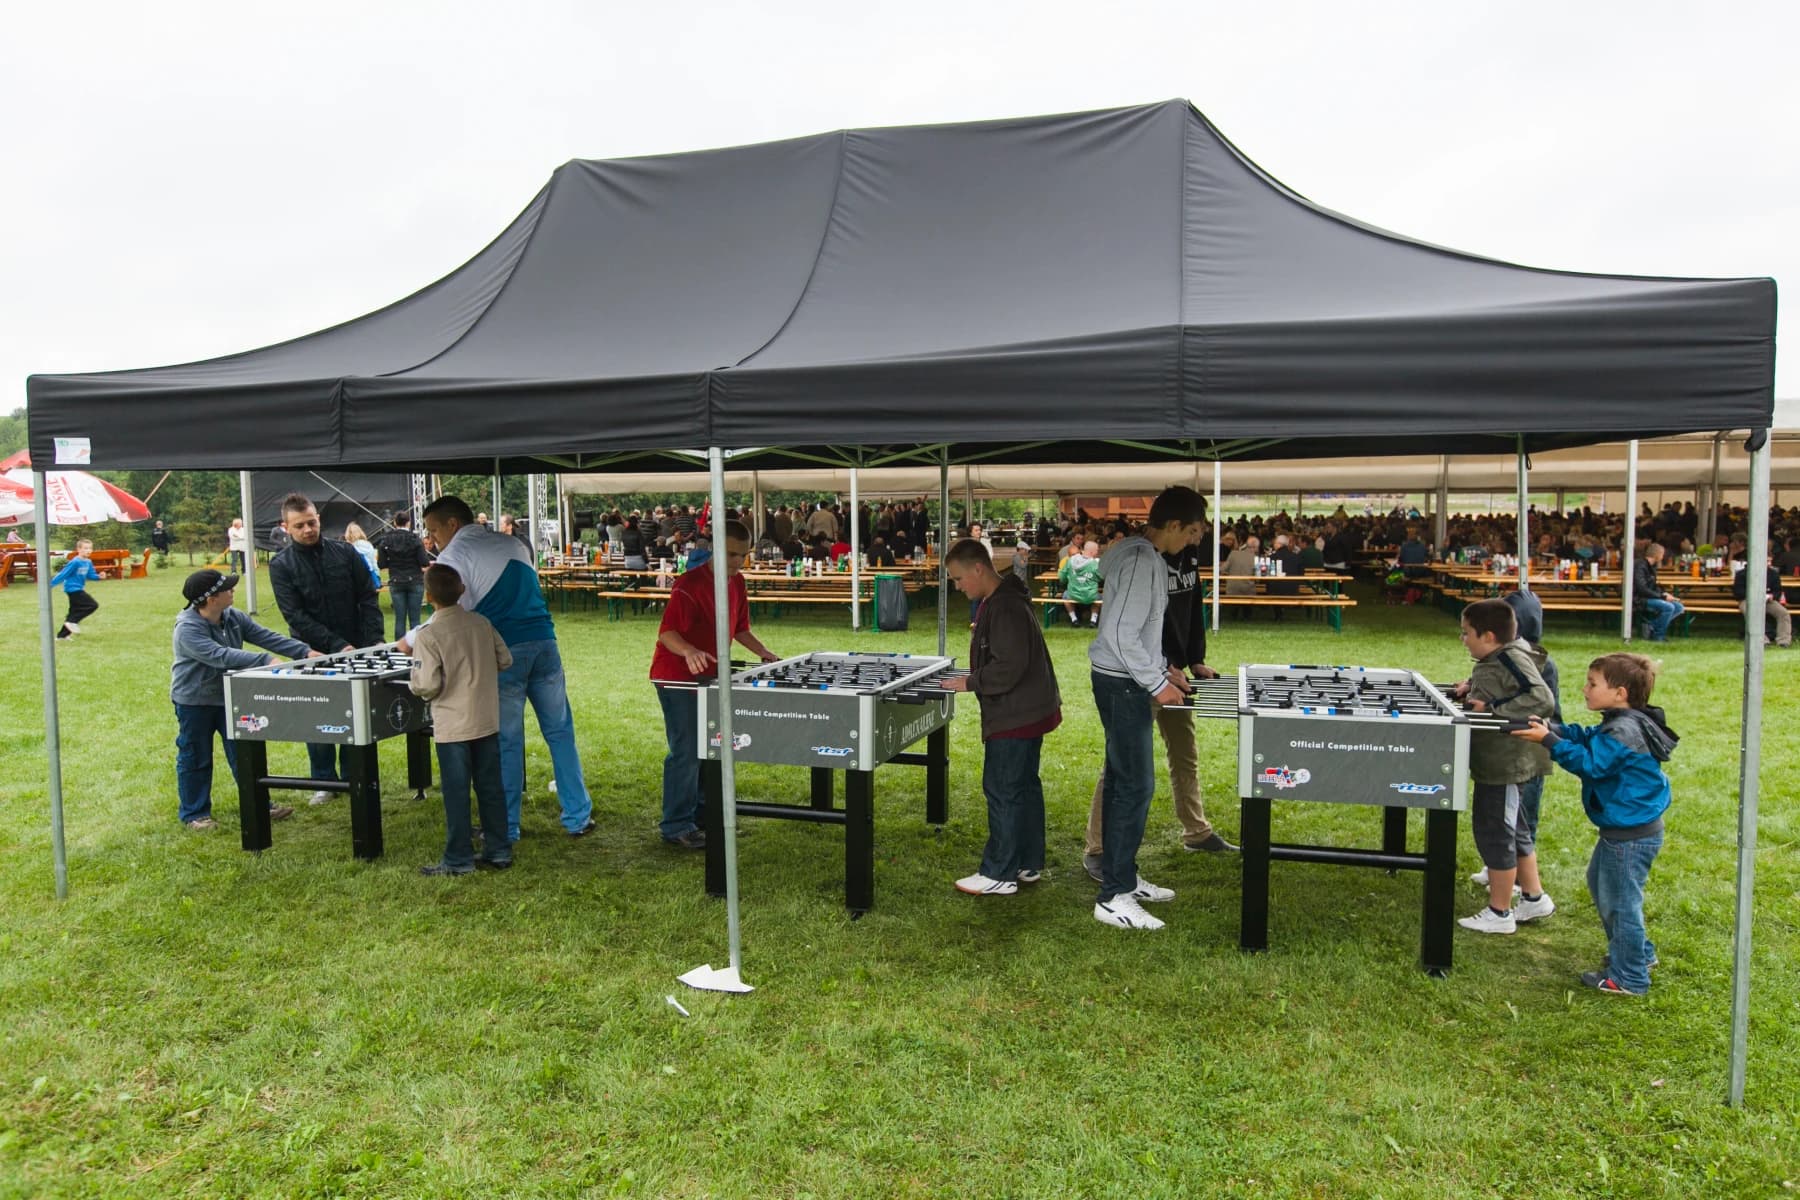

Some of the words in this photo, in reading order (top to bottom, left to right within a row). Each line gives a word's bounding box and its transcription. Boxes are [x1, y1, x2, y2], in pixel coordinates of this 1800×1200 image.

[734, 708, 761, 717] Official
[763, 710, 807, 719] Competition
[1289, 740, 1325, 749] Official
[1327, 742, 1385, 752] Competition
[1387, 745, 1415, 753] Table
[1397, 782, 1446, 794] itsf
